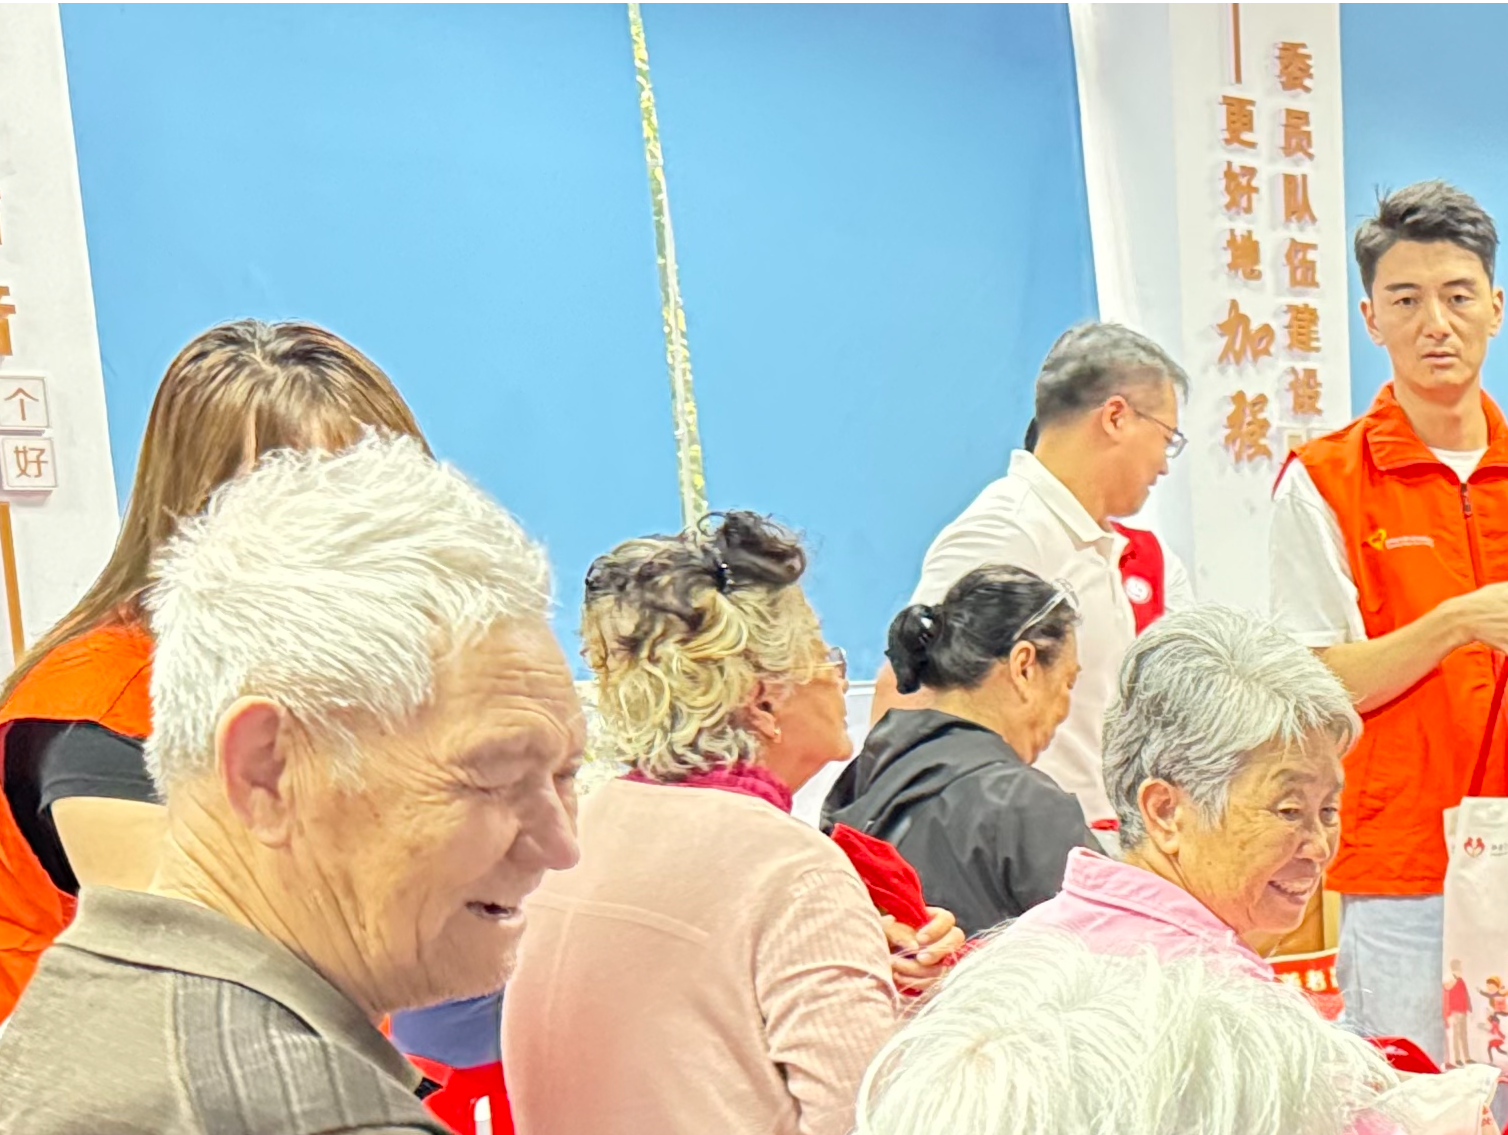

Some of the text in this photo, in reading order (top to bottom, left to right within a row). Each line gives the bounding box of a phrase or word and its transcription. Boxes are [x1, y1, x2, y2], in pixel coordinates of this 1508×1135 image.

[1275, 42, 1323, 417] 委员队伍建设
